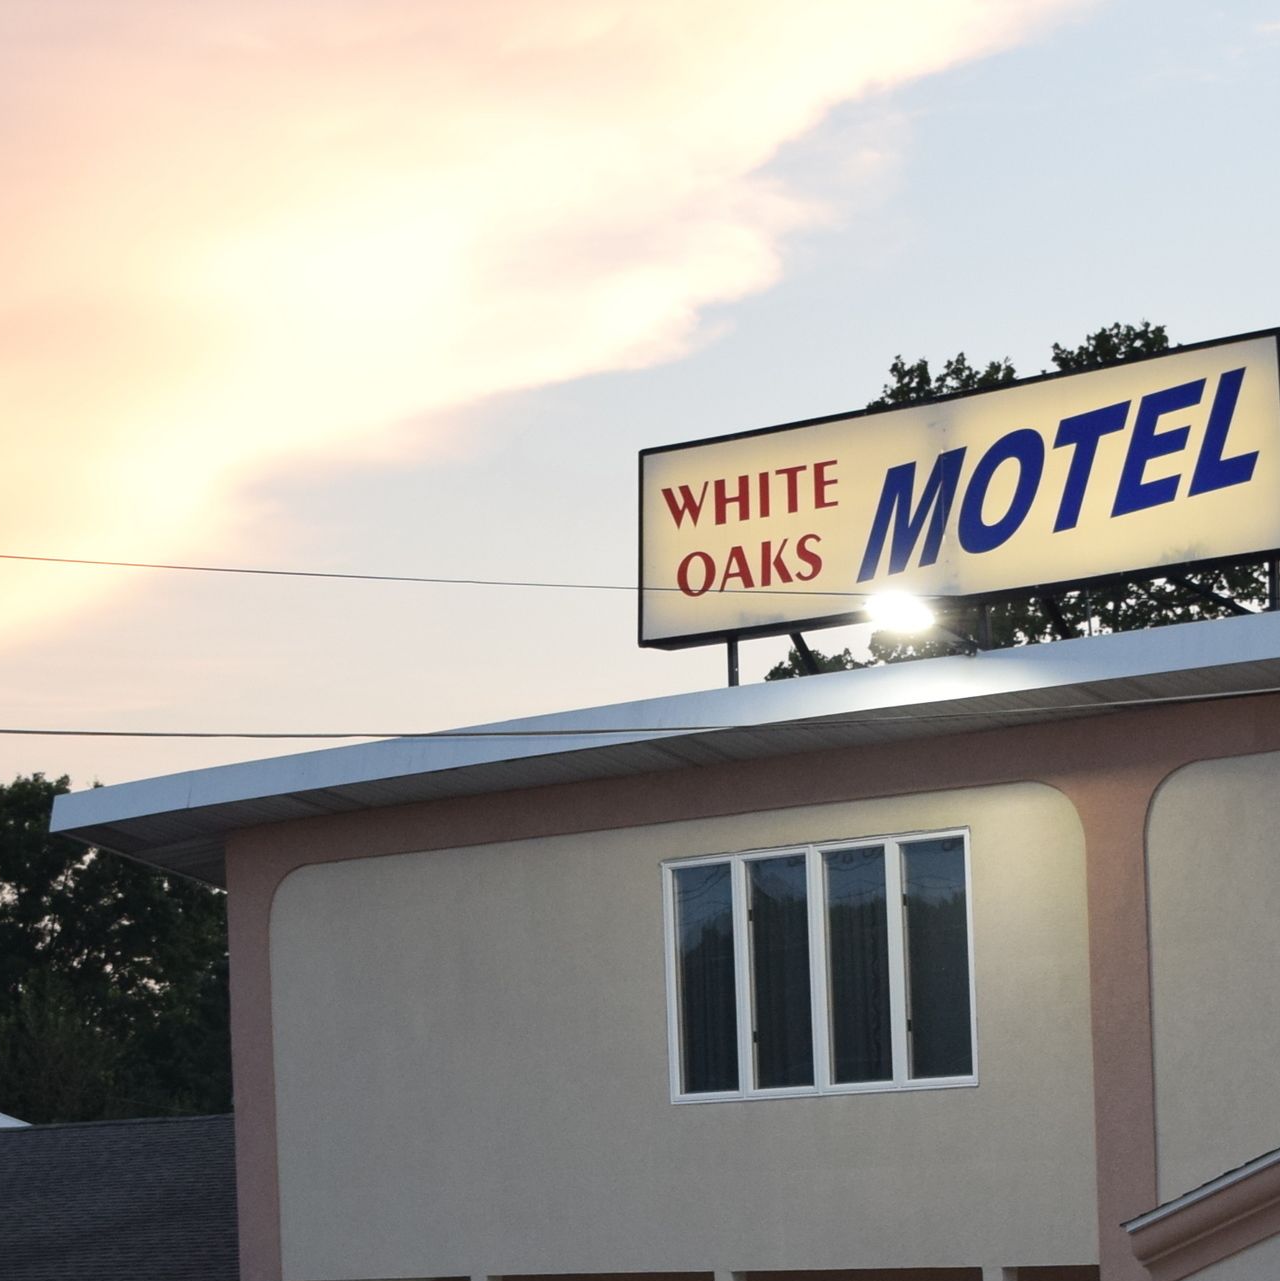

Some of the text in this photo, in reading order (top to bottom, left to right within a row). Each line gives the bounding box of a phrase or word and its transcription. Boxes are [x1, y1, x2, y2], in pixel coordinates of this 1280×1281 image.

[661, 459, 838, 530] WHITE
[856, 366, 1259, 583] MOTEL
[677, 533, 823, 597] OAKS
